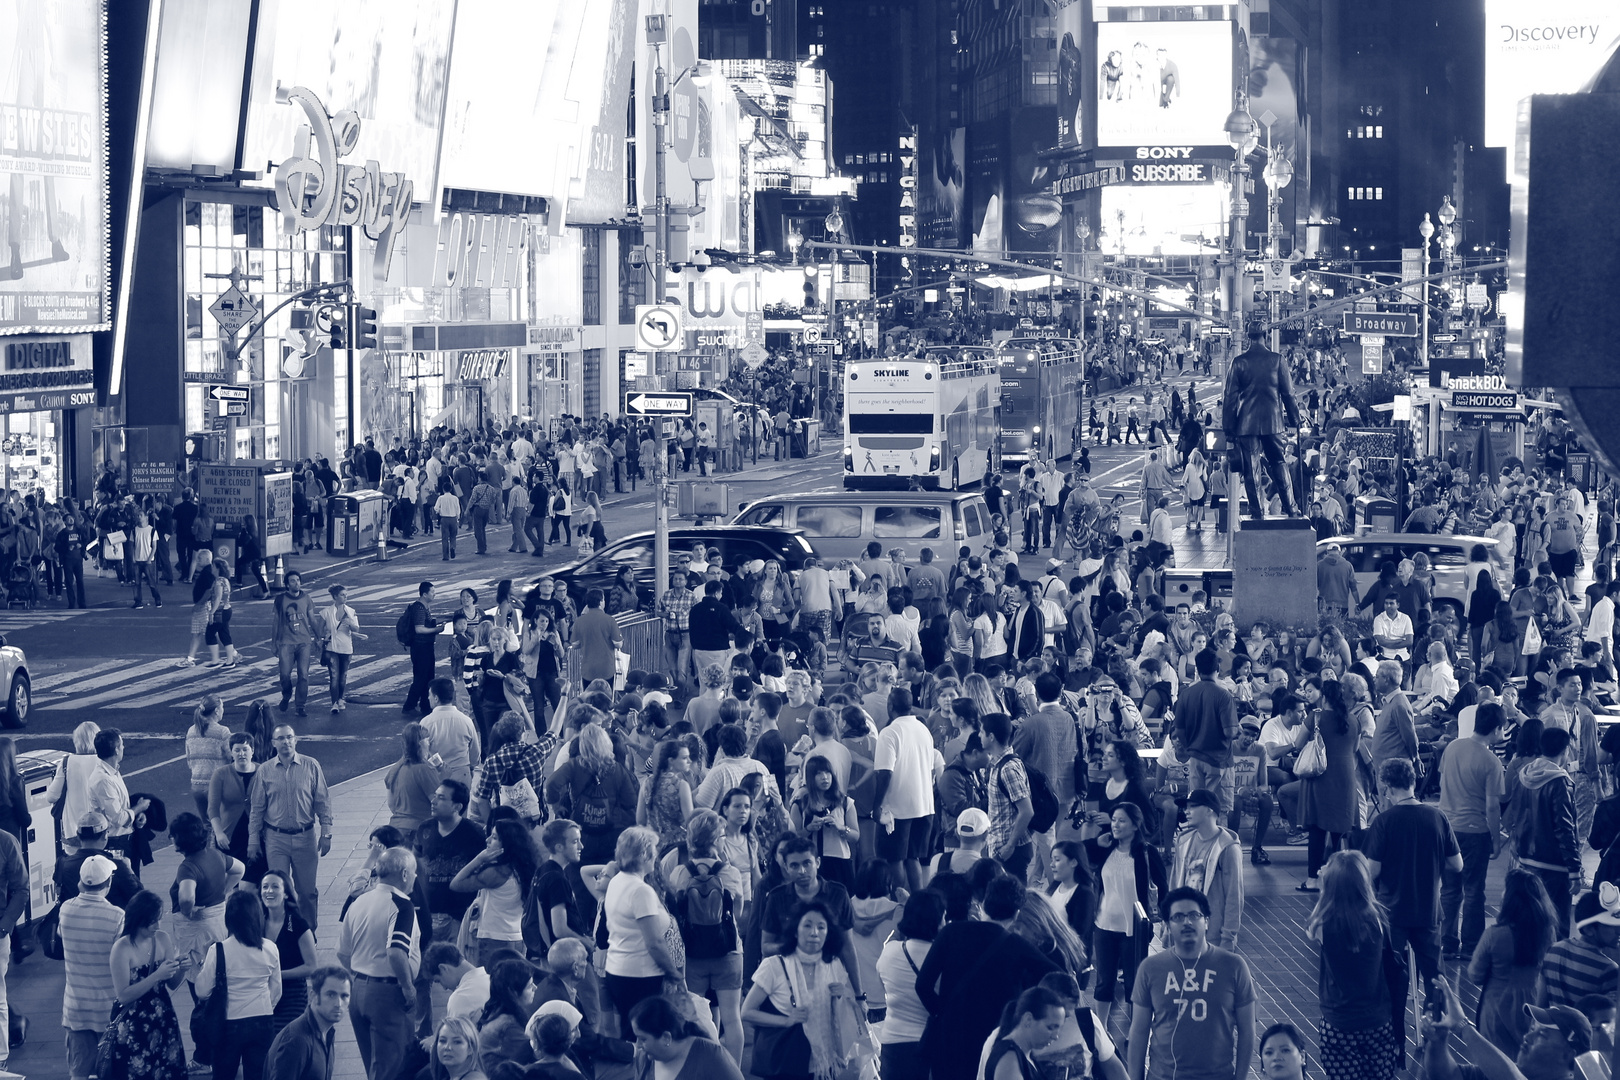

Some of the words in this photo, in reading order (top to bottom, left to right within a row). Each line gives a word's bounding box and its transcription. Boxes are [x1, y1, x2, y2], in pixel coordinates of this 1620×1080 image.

[1500, 24, 1599, 44] Discovery
[1136, 147, 1194, 159] SONY
[65, 164, 91, 176] MUSICAL
[432, 212, 530, 288] FOREVER
[28, 295, 45, 307] BLOCKS
[1355, 317, 1407, 333] Broadway
[697, 334, 741, 346] swatch
[1024, 330, 1060, 338] nuchas
[8, 342, 75, 370] DIGITAL
[459, 352, 500, 380] FOREVER
[680, 357, 688, 370] W
[689, 357, 700, 370] 46
[46, 369, 94, 386] COMPUTERS
[874, 369, 910, 377] SKYLINE
[1448, 375, 1507, 390] snackBOX
[40, 394, 65, 409] Canon
[70, 393, 95, 405] SONY
[643, 400, 660, 408] ONE
[666, 400, 685, 408] WAY
[1469, 395, 1488, 406] HOT
[1488, 396, 1513, 406] DOGS
[132, 468, 148, 476] JOHN'S
[227, 469, 254, 477] STREET
[213, 487, 241, 495] BETWEEN
[585, 803, 606, 817] Kings
[582, 813, 606, 825] Island
[1164, 968, 1217, 995] A&F
[1173, 999, 1207, 1022] 70
